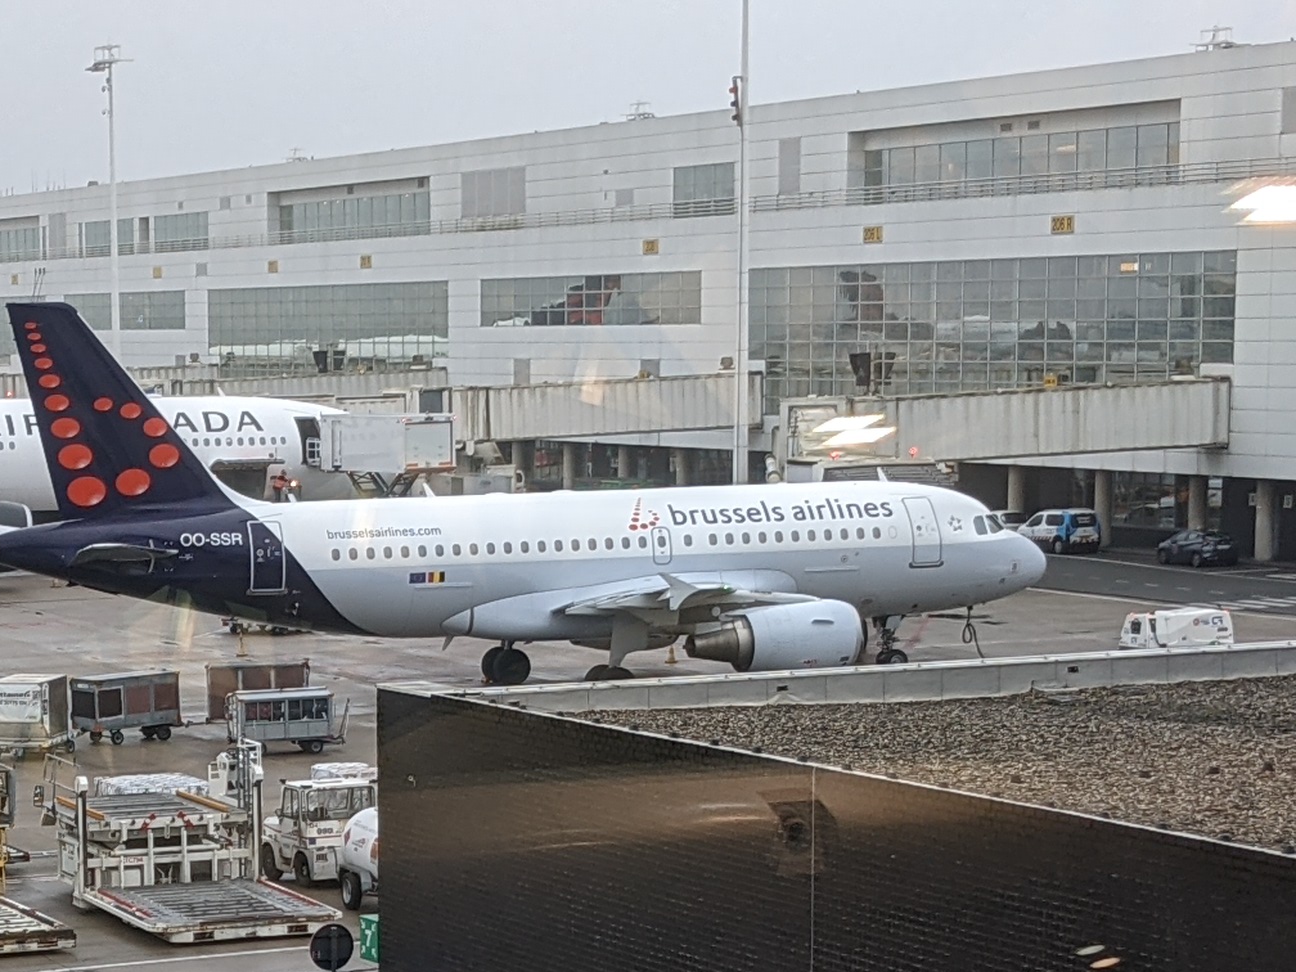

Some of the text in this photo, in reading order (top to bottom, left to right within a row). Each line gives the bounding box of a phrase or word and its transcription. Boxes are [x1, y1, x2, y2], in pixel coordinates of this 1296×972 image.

[667, 497, 894, 526] brussels airlines
[179, 532, 244, 548] OO-SSR
[326, 526, 443, 540] brusselsairlines.com
[364, 928, 373, 947] 7
